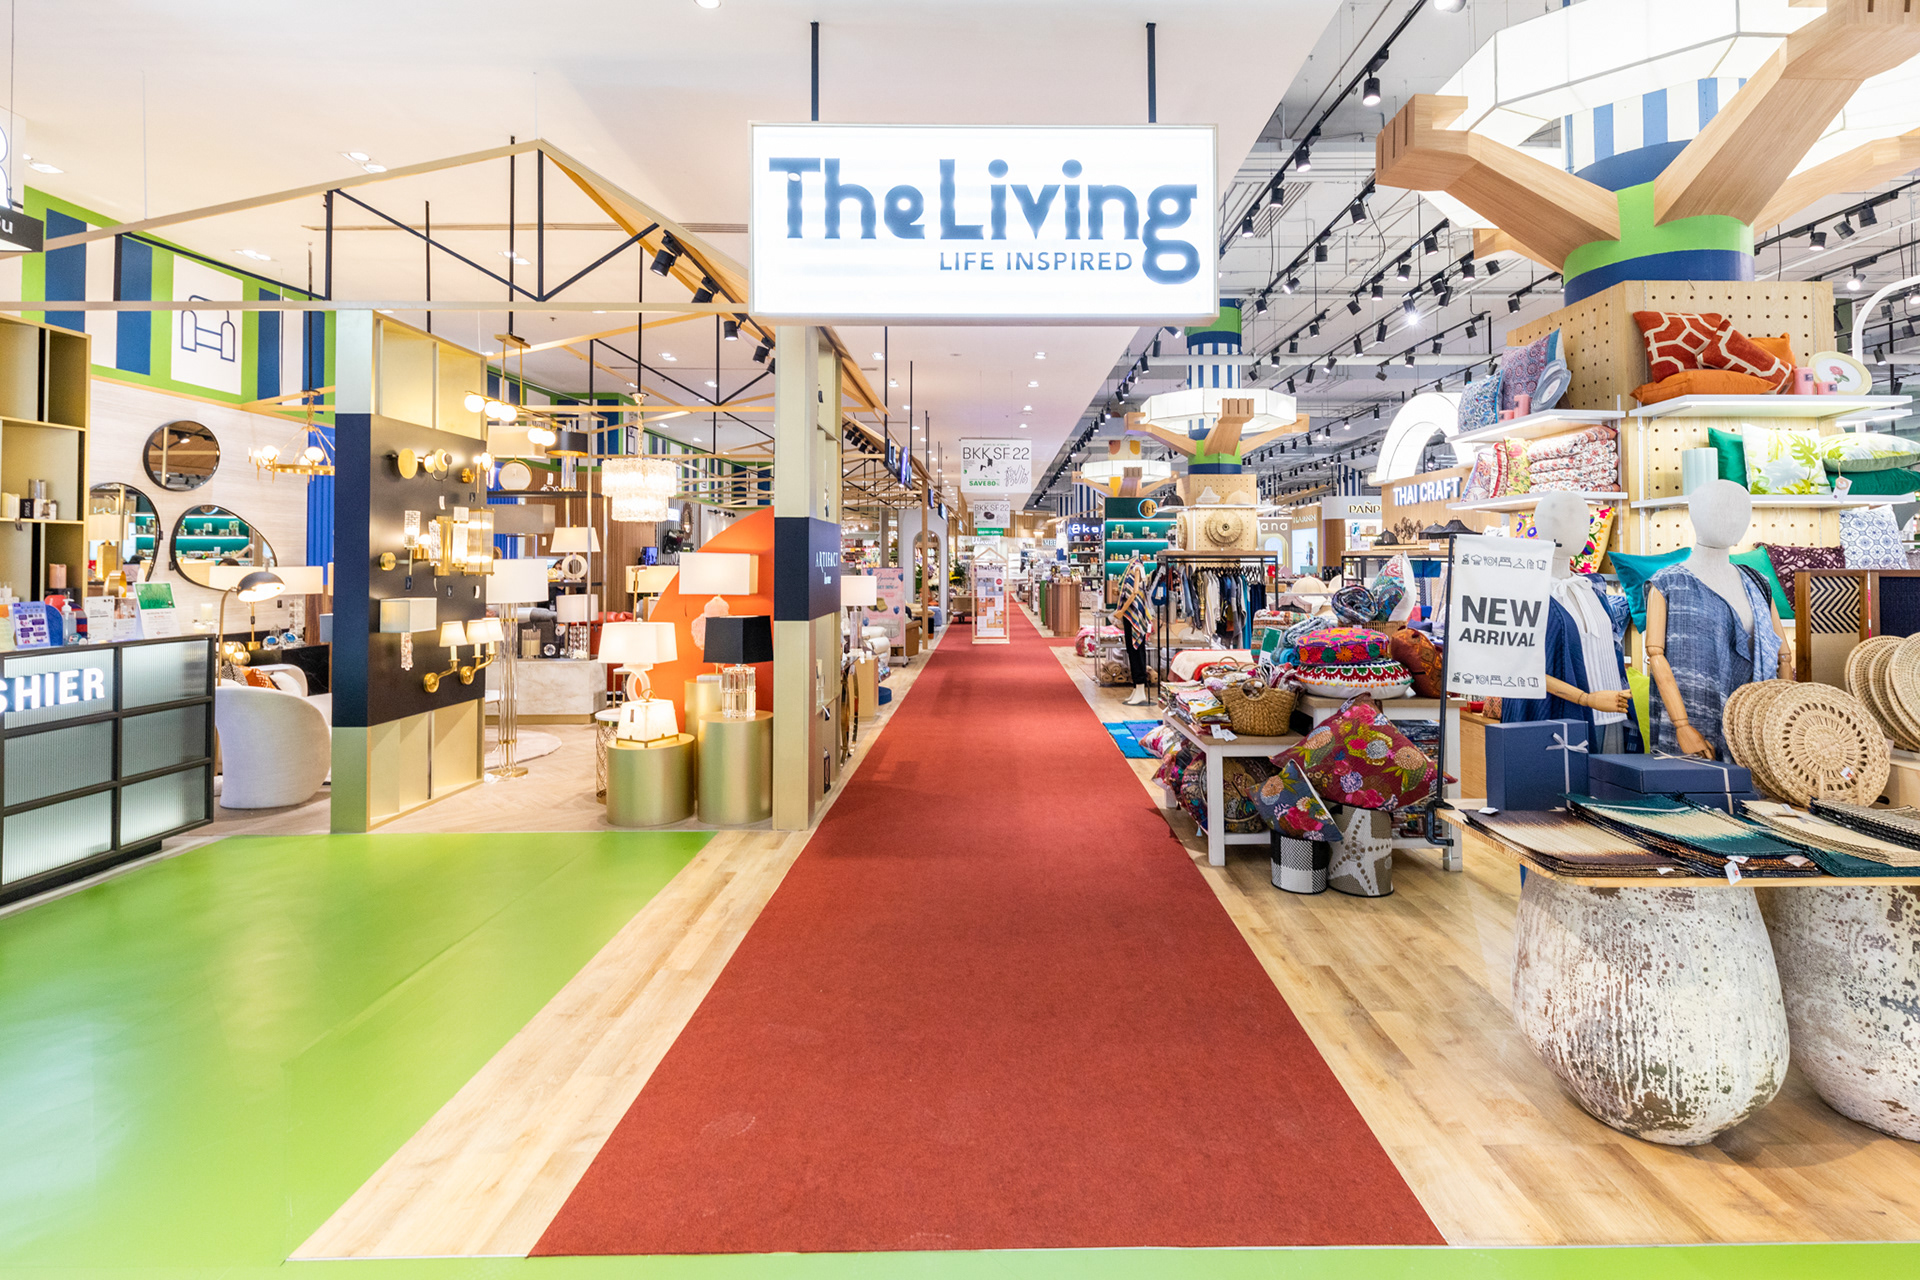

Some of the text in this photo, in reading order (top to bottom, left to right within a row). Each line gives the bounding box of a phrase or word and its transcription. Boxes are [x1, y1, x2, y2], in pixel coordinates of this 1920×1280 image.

[940, 251, 1133, 271] LIFE INSPIRED
[963, 447, 1030, 460] BKK SF 22
[1393, 477, 1462, 507] THAI CRAFT
[1261, 522, 1288, 531] ana
[815, 551, 838, 569] ARTIFACT
[1461, 595, 1542, 628] NEW
[1458, 627, 1536, 648] ARRIVAL
